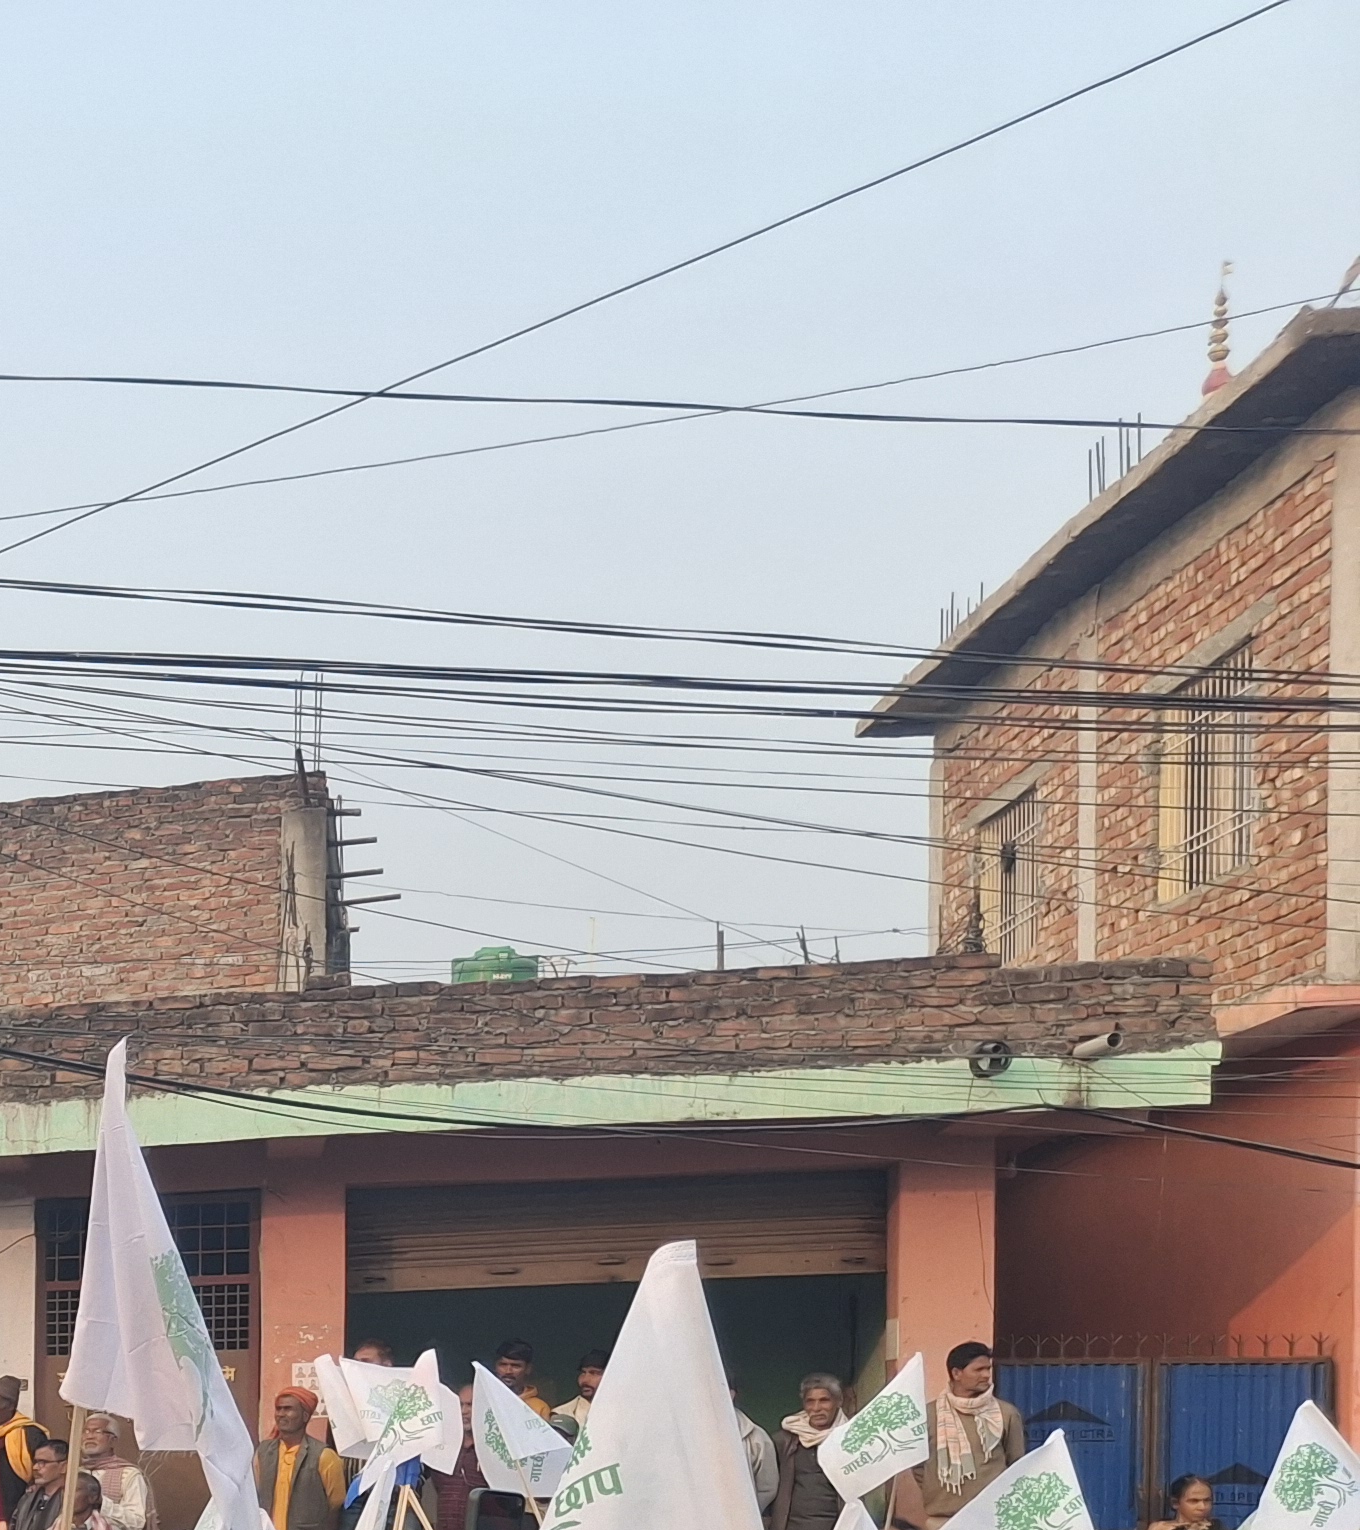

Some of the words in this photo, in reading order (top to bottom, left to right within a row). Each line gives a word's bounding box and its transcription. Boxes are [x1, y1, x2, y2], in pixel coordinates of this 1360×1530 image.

[420, 1411, 444, 1426] छाप
[841, 1451, 874, 1475] गाछी
[554, 1463, 624, 1518] छाप
[1063, 1495, 1084, 1514] छा
[1310, 1500, 1337, 1528] गाछी
